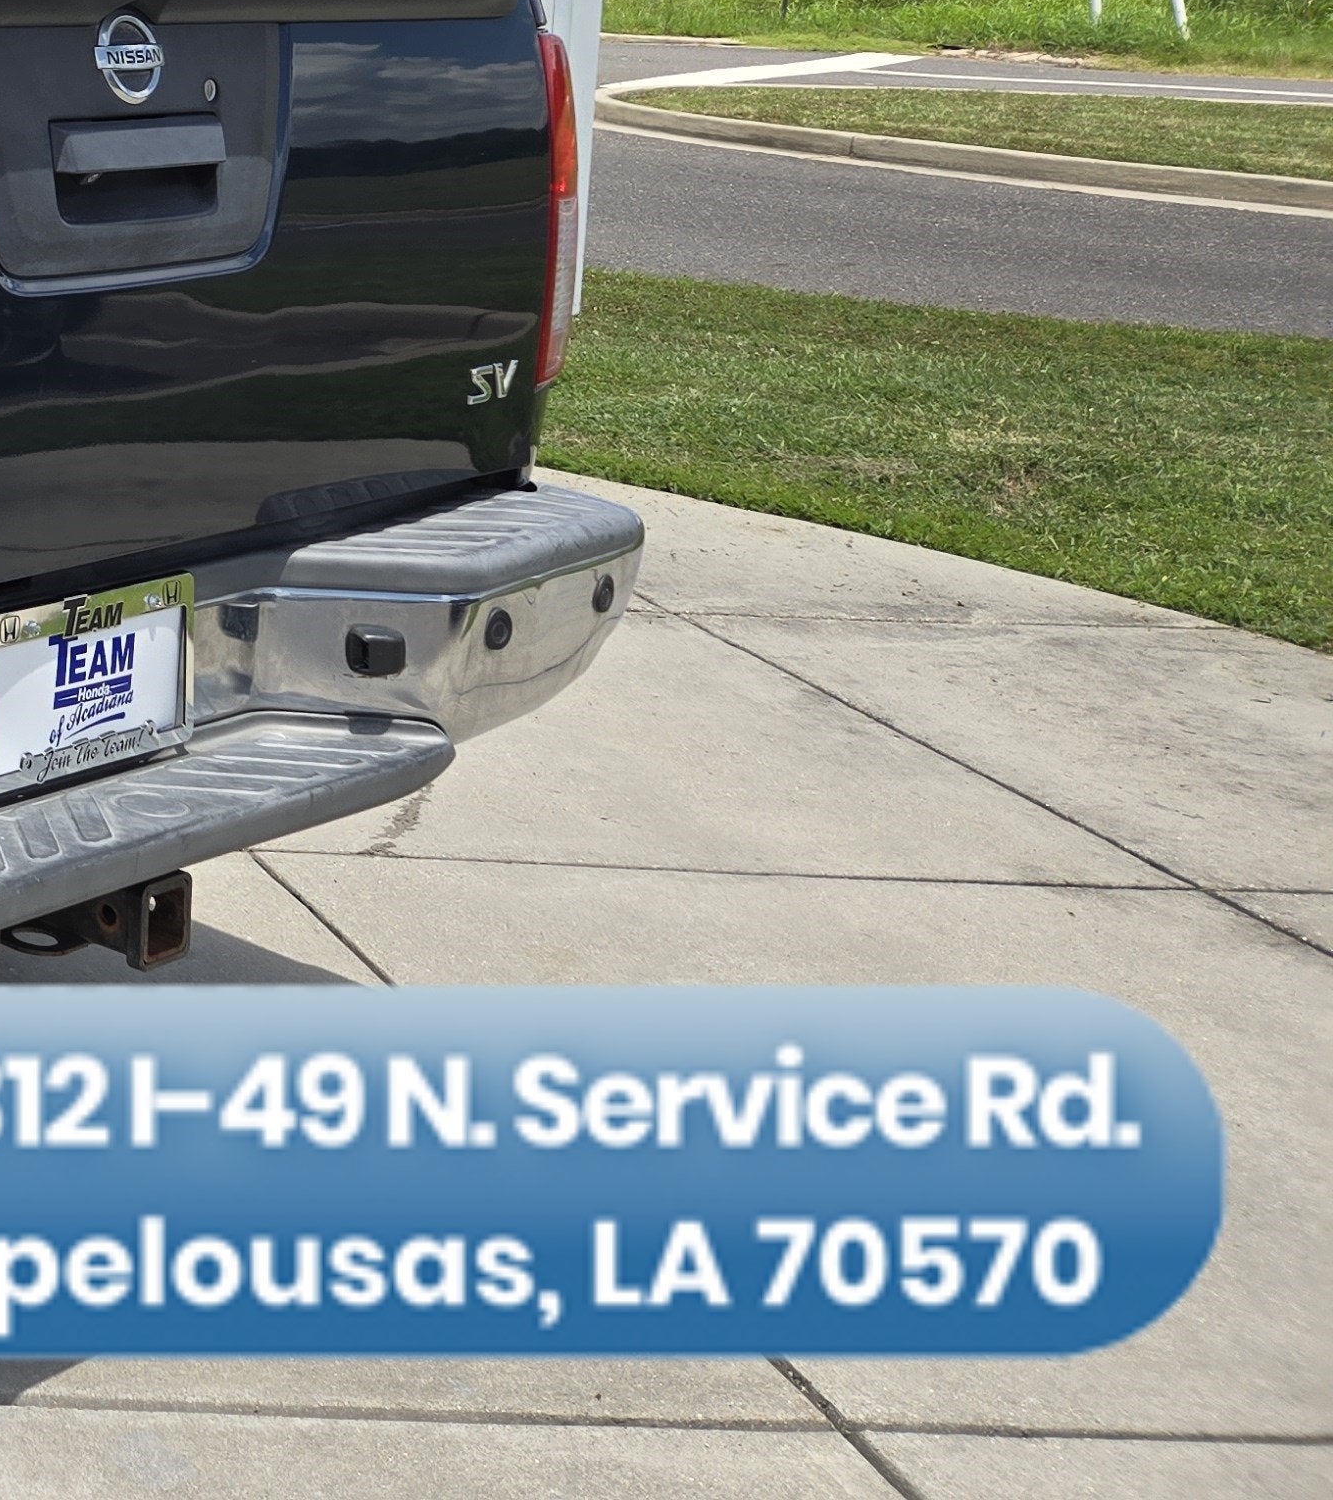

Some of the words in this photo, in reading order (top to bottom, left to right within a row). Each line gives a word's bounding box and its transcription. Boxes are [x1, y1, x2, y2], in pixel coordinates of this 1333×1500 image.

[106, 48, 161, 65] NISSAN
[466, 359, 519, 406] SV
[62, 594, 124, 638] TEAM
[48, 632, 136, 688] TEAM
[77, 683, 110, 702] Honda
[49, 714, 66, 748] of
[66, 689, 134, 731] Acadiana
[36, 747, 71, 783] Join
[73, 738, 99, 765] The
